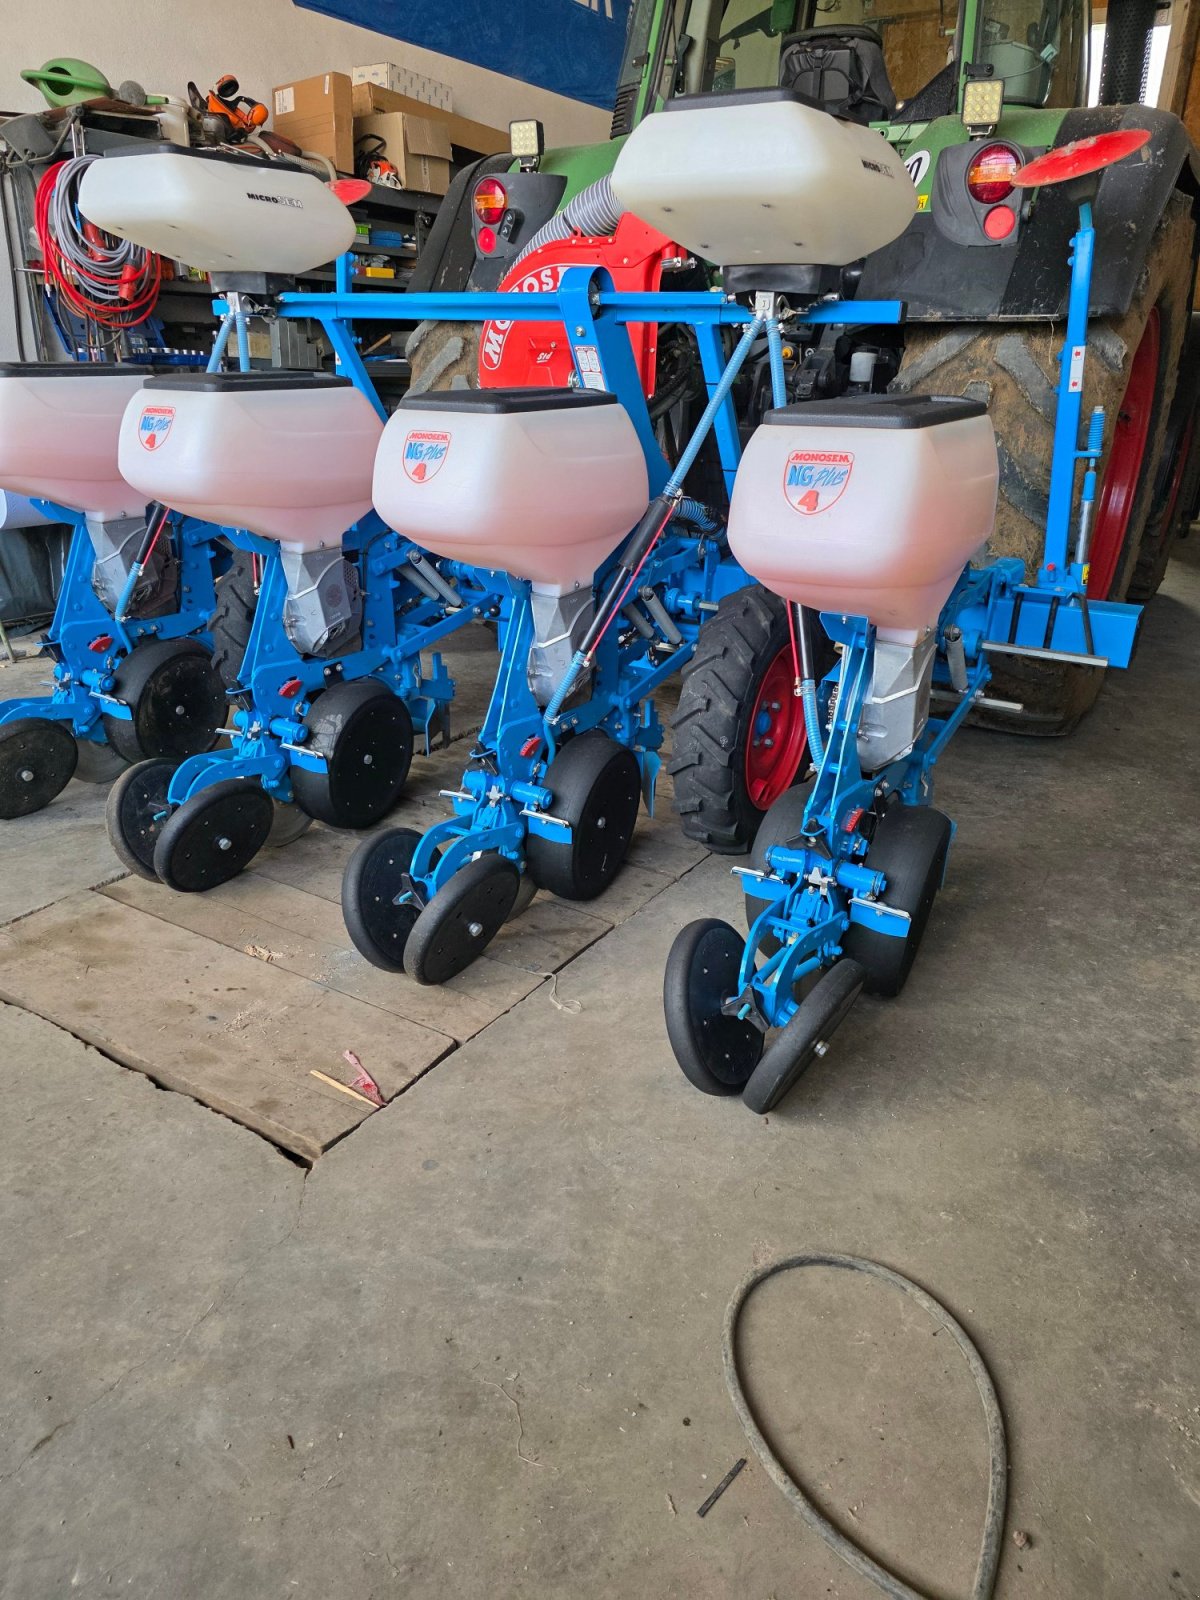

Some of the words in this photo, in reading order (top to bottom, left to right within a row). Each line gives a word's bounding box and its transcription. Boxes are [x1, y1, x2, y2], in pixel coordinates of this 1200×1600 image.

[246, 192, 304, 209] MICROSEM
[141, 415, 155, 431] NG
[145, 433, 156, 449] 4
[409, 432, 448, 441] MONOSEM
[405, 442, 424, 460] NG
[791, 453, 850, 463] MONOSEM
[411, 462, 426, 481] 4
[787, 465, 815, 487] NG
[797, 489, 819, 511] 4
